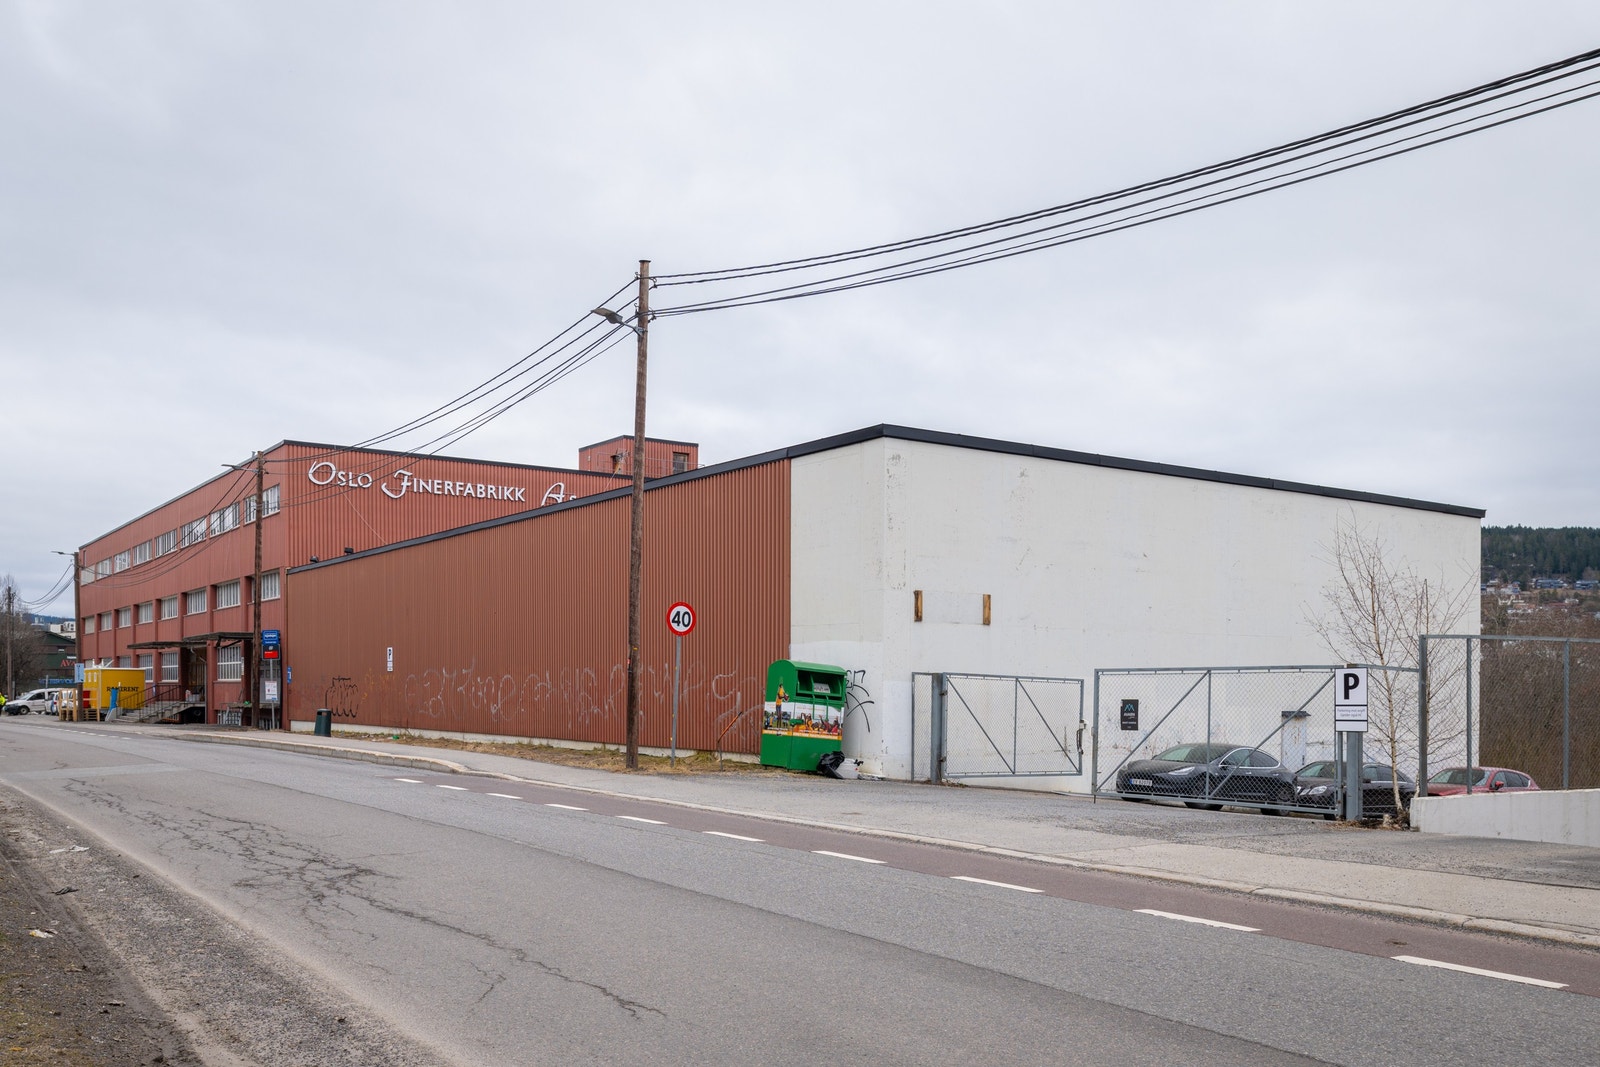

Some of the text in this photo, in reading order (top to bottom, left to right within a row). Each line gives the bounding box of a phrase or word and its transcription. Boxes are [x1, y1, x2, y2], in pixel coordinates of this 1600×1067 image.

[308, 460, 373, 488] OSLO
[381, 469, 526, 502] FINERFABRIKK
[671, 611, 691, 628] 40
[1343, 672, 1360, 700] P
